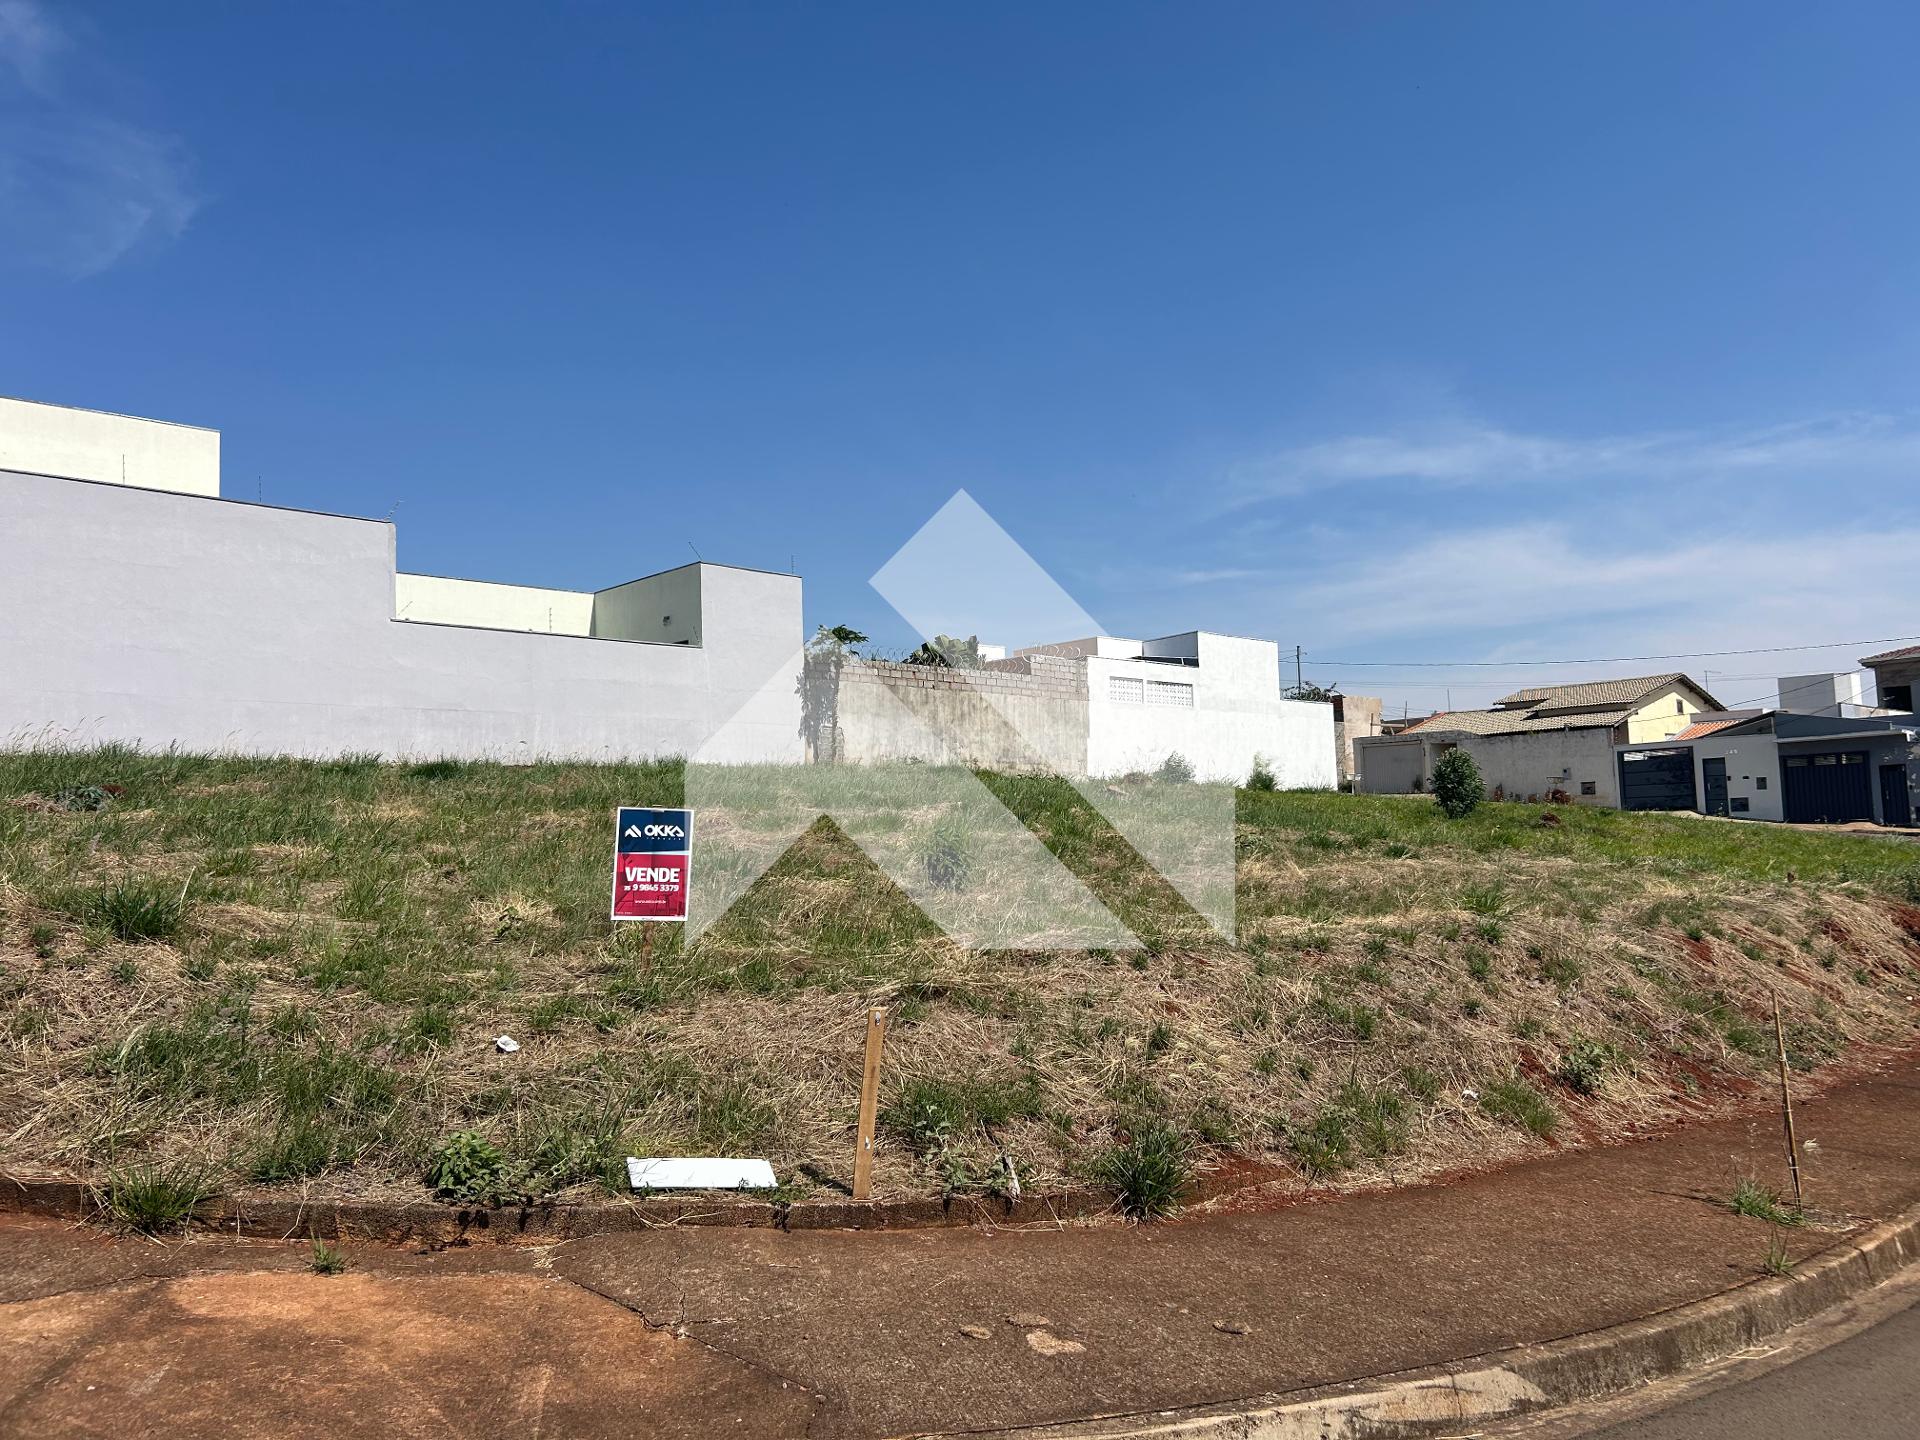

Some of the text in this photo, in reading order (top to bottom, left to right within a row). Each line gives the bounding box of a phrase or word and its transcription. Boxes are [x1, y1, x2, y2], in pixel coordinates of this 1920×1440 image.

[644, 824, 685, 837] OKKA
[625, 866, 680, 882] VENDE
[660, 884, 679, 892] 3379
